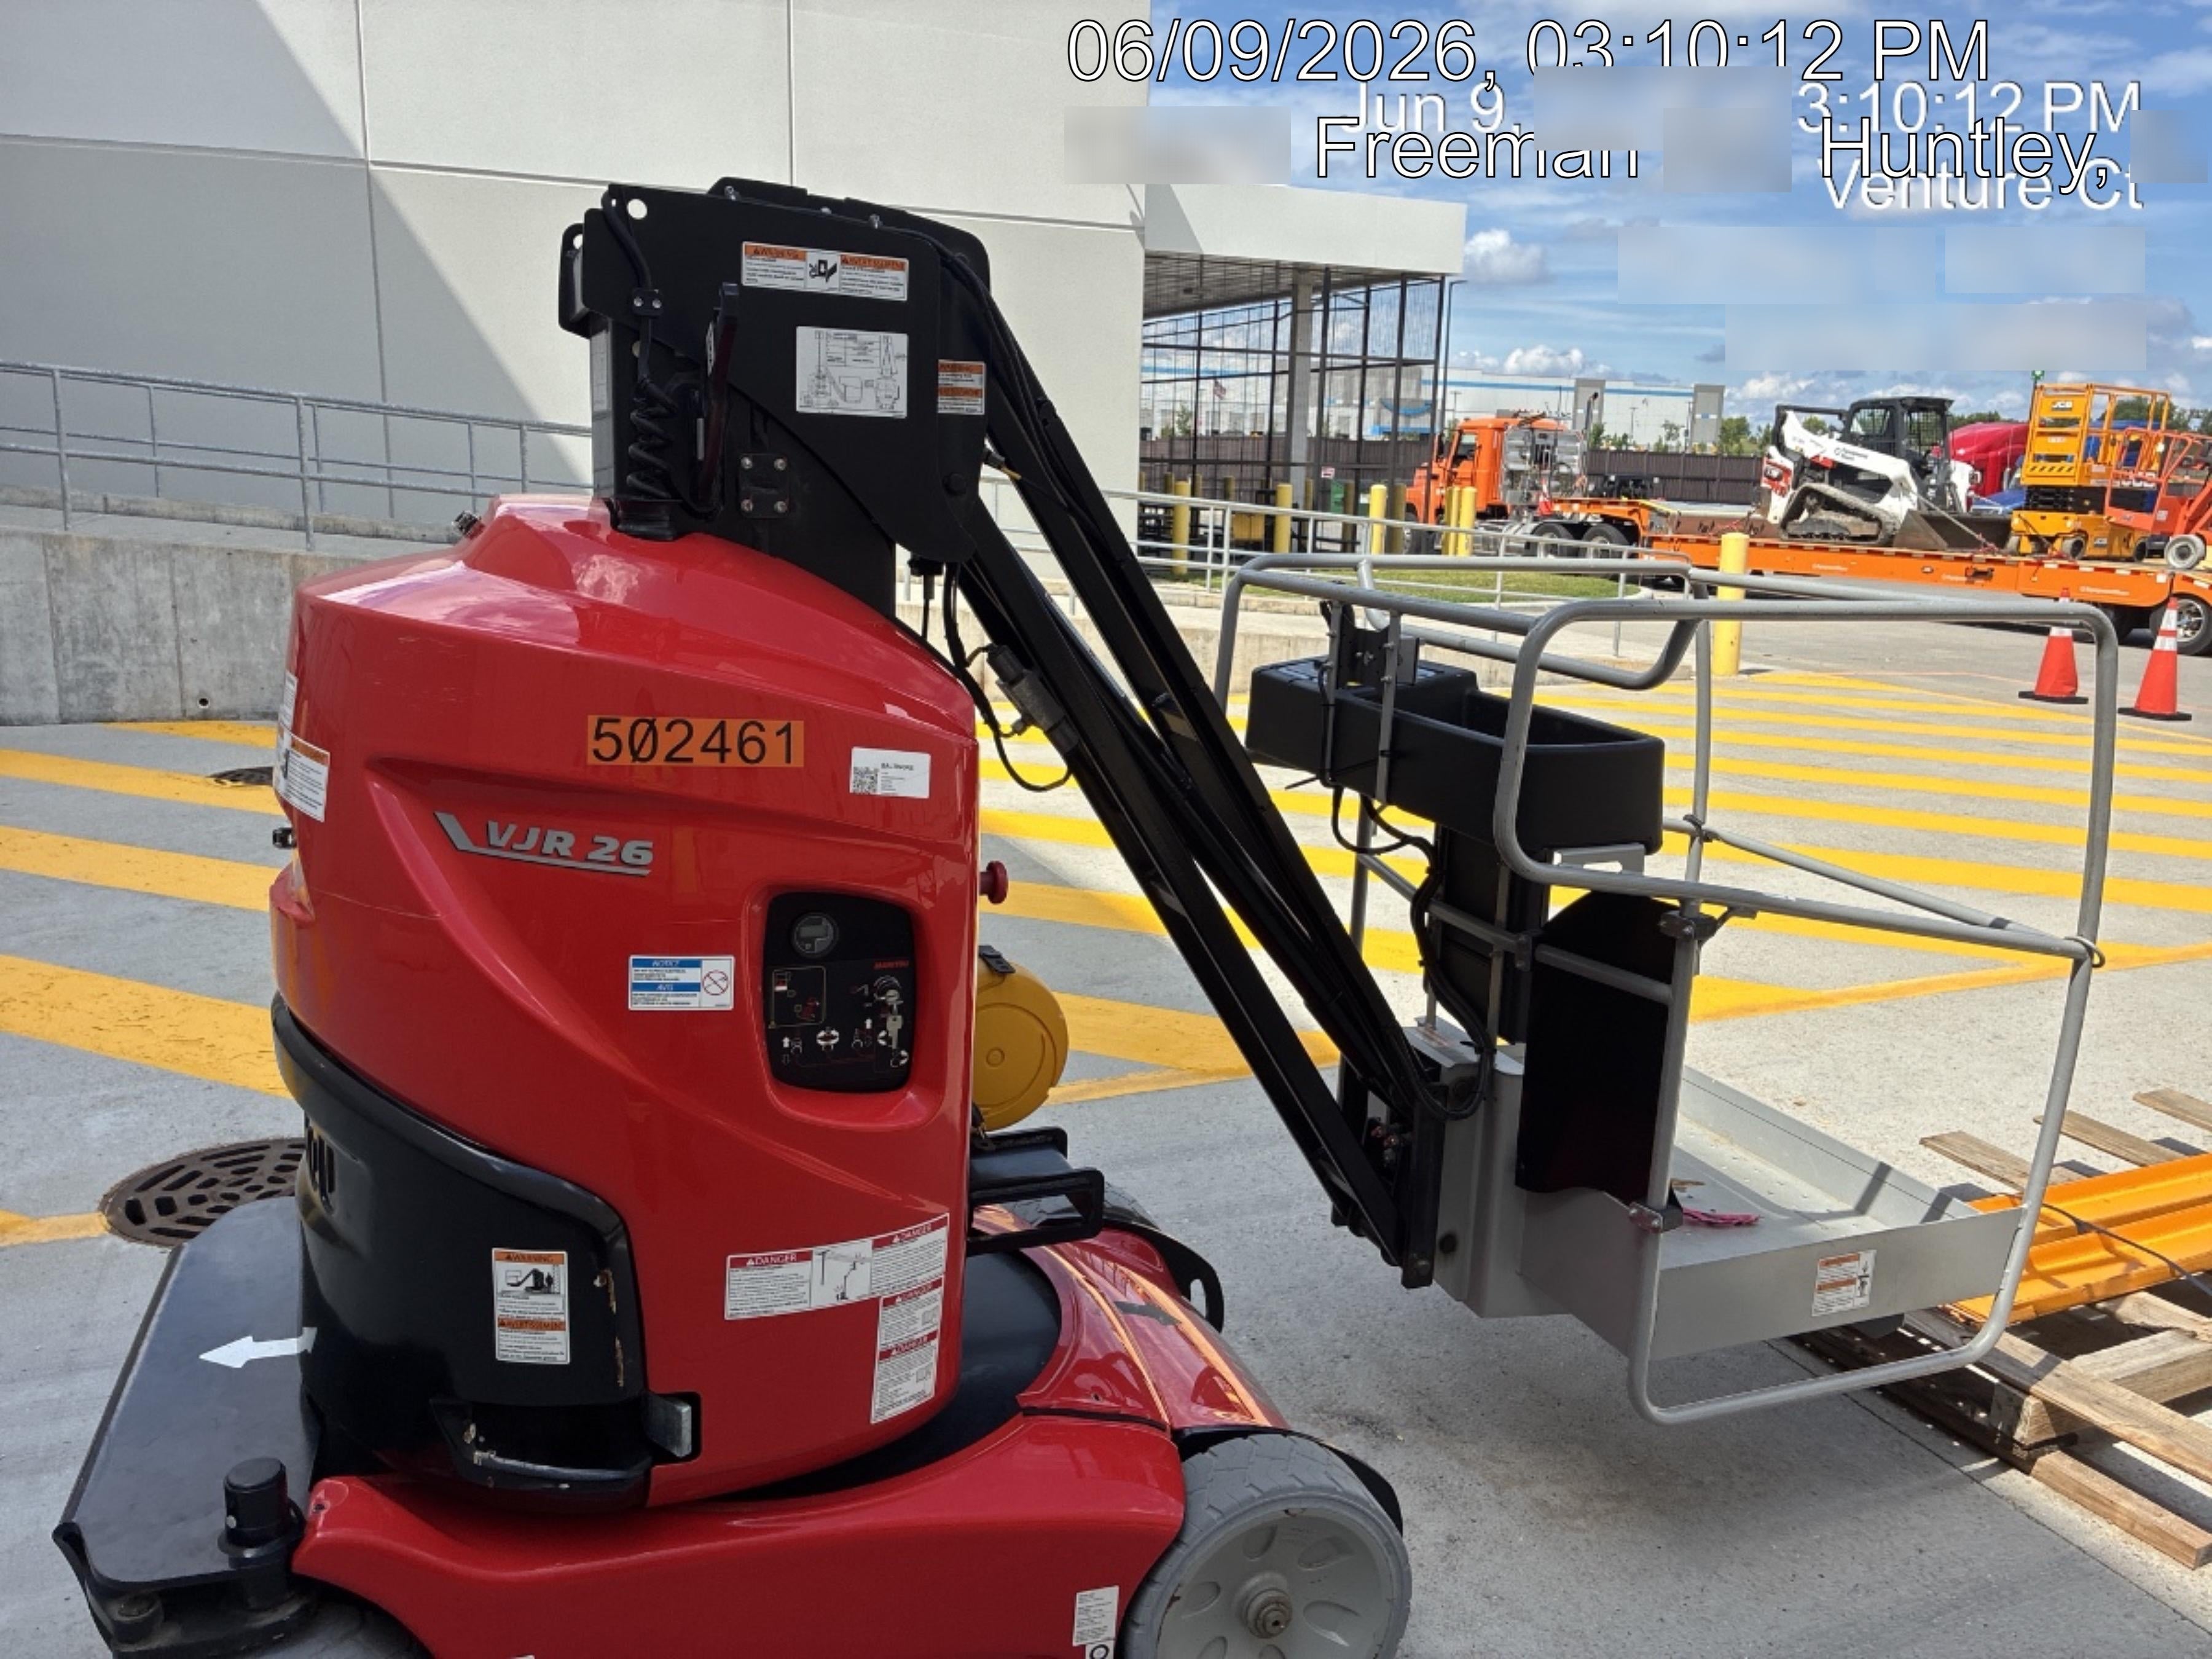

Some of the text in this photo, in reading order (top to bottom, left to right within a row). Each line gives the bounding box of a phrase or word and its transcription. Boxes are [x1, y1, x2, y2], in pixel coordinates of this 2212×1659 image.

[592, 717, 791, 764] 502461
[487, 820, 653, 865] VJR 26
[755, 1254, 798, 1265] DANGER
